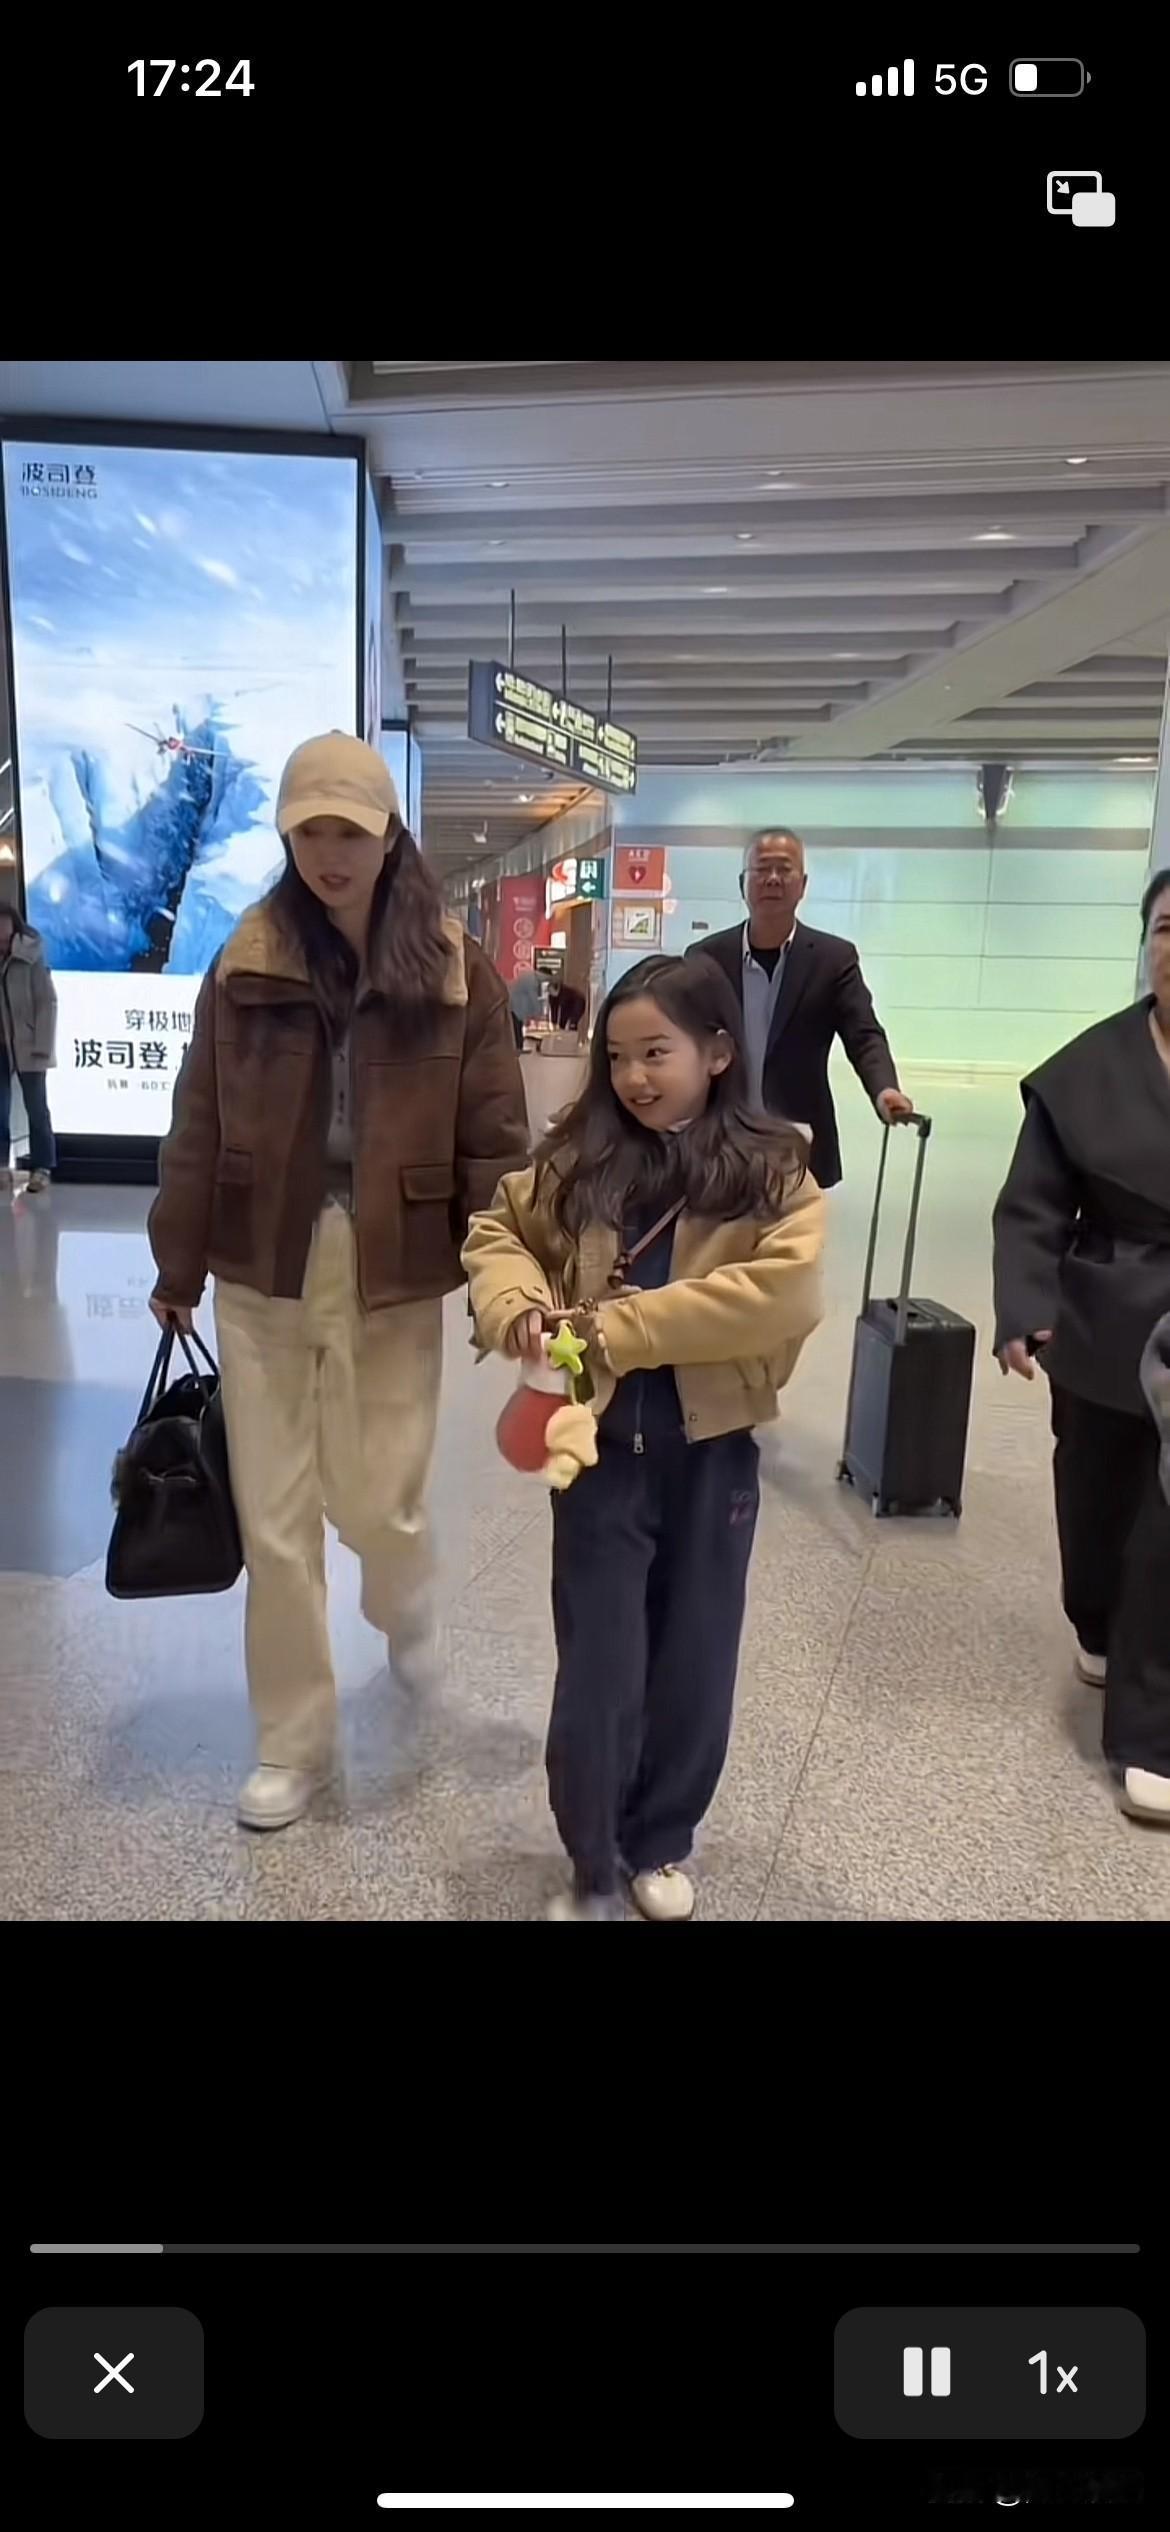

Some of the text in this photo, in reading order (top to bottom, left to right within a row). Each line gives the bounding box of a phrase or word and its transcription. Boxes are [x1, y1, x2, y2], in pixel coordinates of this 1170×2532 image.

[22, 462, 97, 485] 波司登
[21, 485, 98, 499] BOSIDENG
[74, 1038, 168, 1070] 波司登
